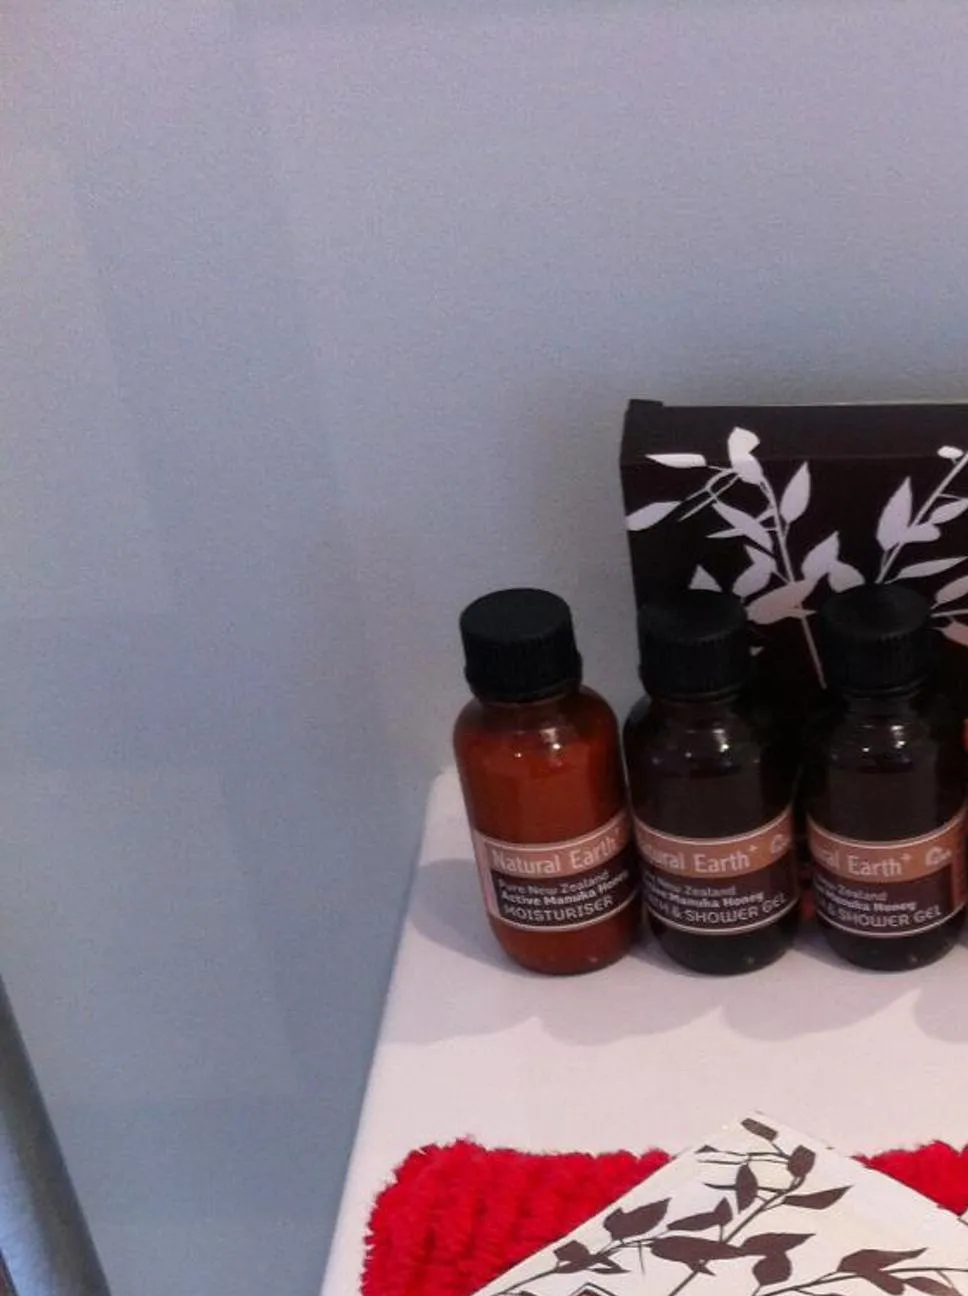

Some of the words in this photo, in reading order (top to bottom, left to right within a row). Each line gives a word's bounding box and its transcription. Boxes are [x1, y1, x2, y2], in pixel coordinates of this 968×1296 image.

[491, 848, 562, 875] Natural
[570, 836, 618, 870] Earth
[694, 850, 751, 873] Earth
[848, 854, 902, 877] Earth
[543, 888, 596, 905] Manuka
[723, 892, 764, 907] Honey
[873, 901, 918, 911] Honey
[503, 895, 613, 921] MOISTURISER
[686, 906, 759, 924] SHOWER
[838, 908, 910, 927] SHOWER
[915, 905, 941, 923] GEL
